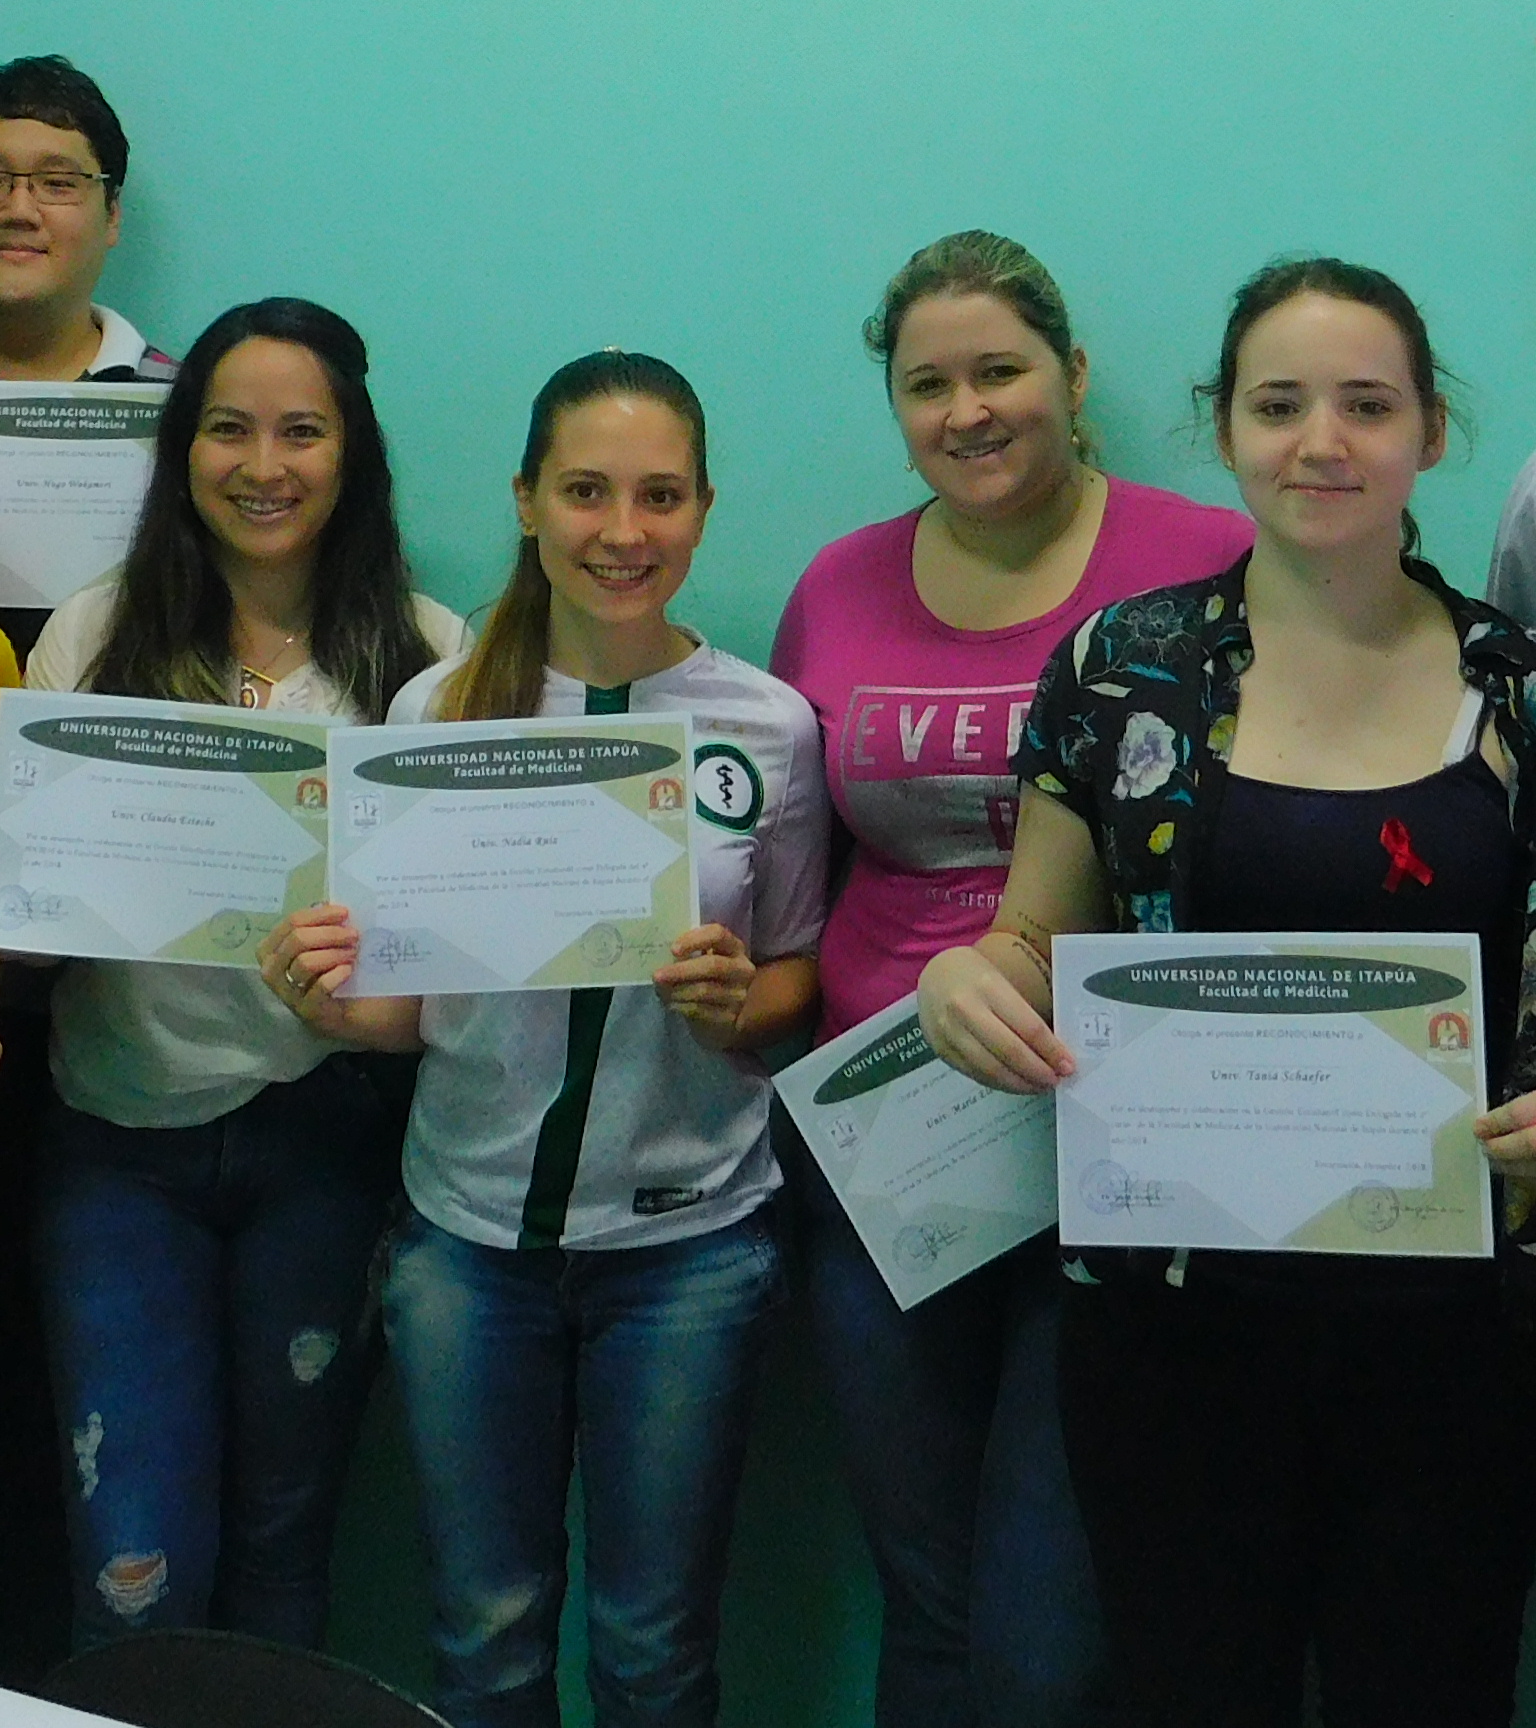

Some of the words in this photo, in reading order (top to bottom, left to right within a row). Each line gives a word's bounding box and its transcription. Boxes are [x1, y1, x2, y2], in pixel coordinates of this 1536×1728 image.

[50, 407, 111, 418] NACIONAL
[115, 408, 130, 418] DE
[134, 409, 159, 419] ITAP
[15, 417, 60, 429] Facultad
[63, 418, 76, 429] de
[78, 419, 127, 430] Medicina
[59, 721, 150, 739] UNIVERSIDAD
[154, 729, 221, 747] NACIONAL
[225, 737, 243, 749] DE
[246, 738, 293, 754] ITAPÚA
[114, 739, 165, 755] Facultad
[167, 744, 182, 756] de
[184, 746, 238, 761] Medicina
[394, 752, 488, 767] UNIVERSIDAD
[492, 748, 564, 763] NACIONAL
[568, 747, 585, 758] DE
[590, 743, 640, 759] ITAPÚA
[453, 764, 506, 778] Facultad
[509, 763, 524, 775] de
[527, 762, 583, 775] Medicina
[1130, 969, 1238, 982] UNIVERSIDAD
[1244, 969, 1326, 982] NACIONAL
[1332, 970, 1352, 982] DE
[1358, 968, 1416, 983] ITAPÚA
[1198, 985, 1258, 998] Facultad
[1263, 985, 1279, 998] de
[1284, 985, 1349, 999] Medicina
[843, 1027, 923, 1078] UNIVERSIDAD
[898, 1039, 929, 1063] Facul
[1281, 1069, 1332, 1085] Schaefer
